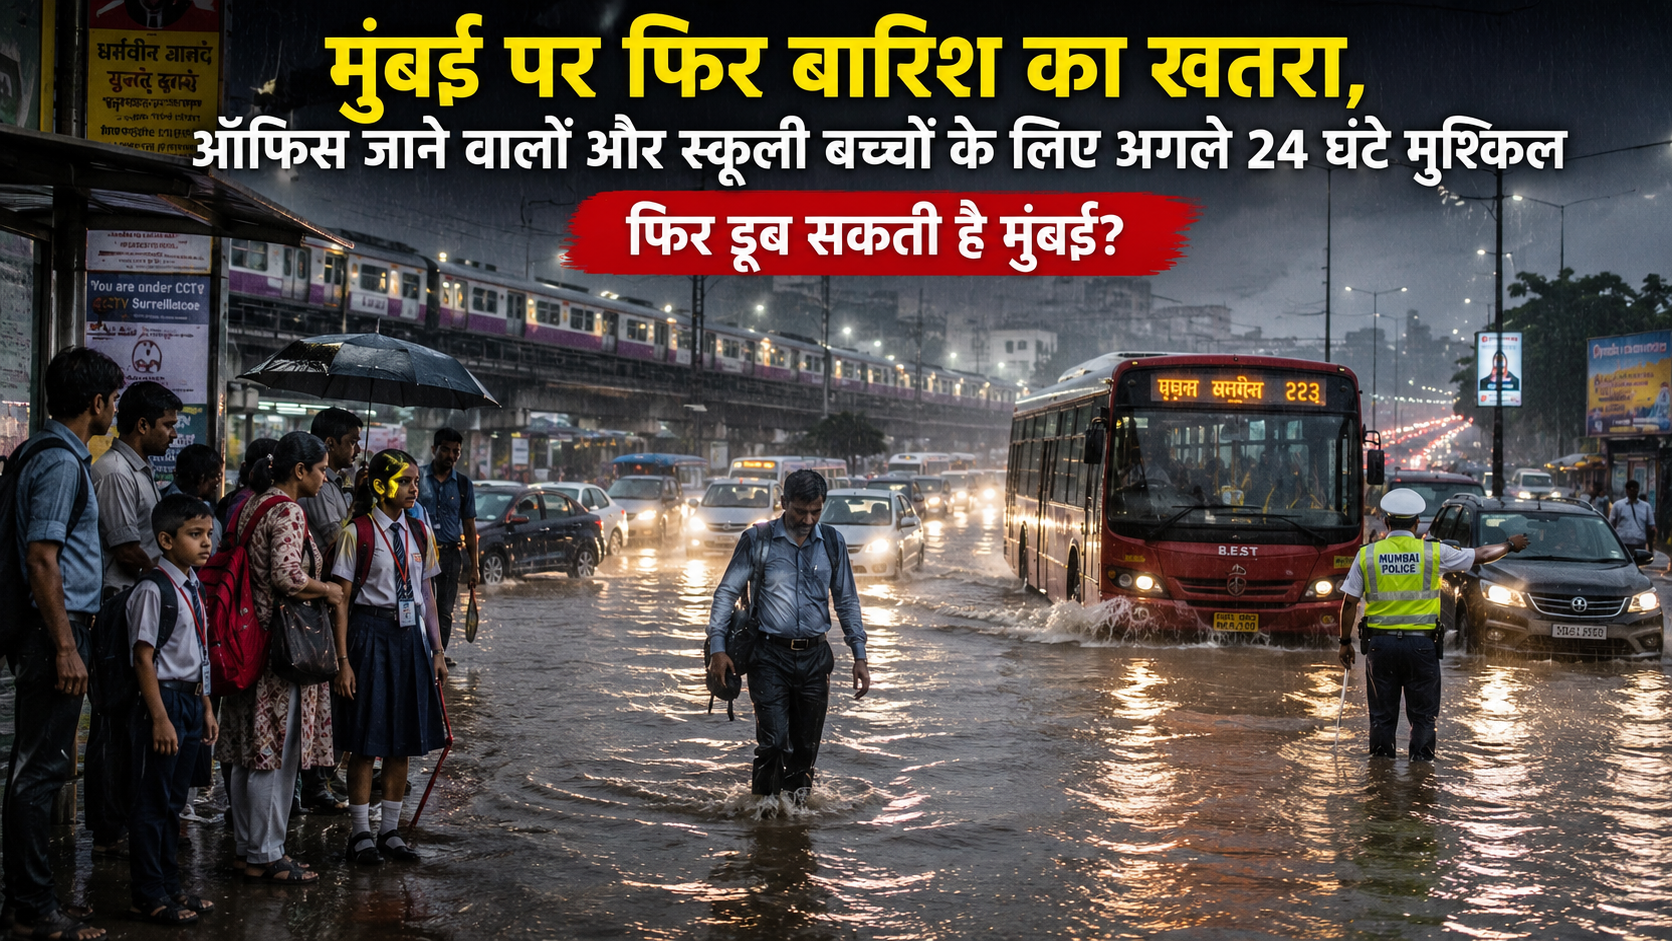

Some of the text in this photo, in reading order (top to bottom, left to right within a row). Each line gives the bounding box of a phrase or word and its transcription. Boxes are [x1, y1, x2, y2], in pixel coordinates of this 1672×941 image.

[90, 280, 113, 292] You
[116, 283, 135, 292] are
[1379, 553, 1420, 564] MUMBAI
[1382, 564, 1416, 574] POLICE
